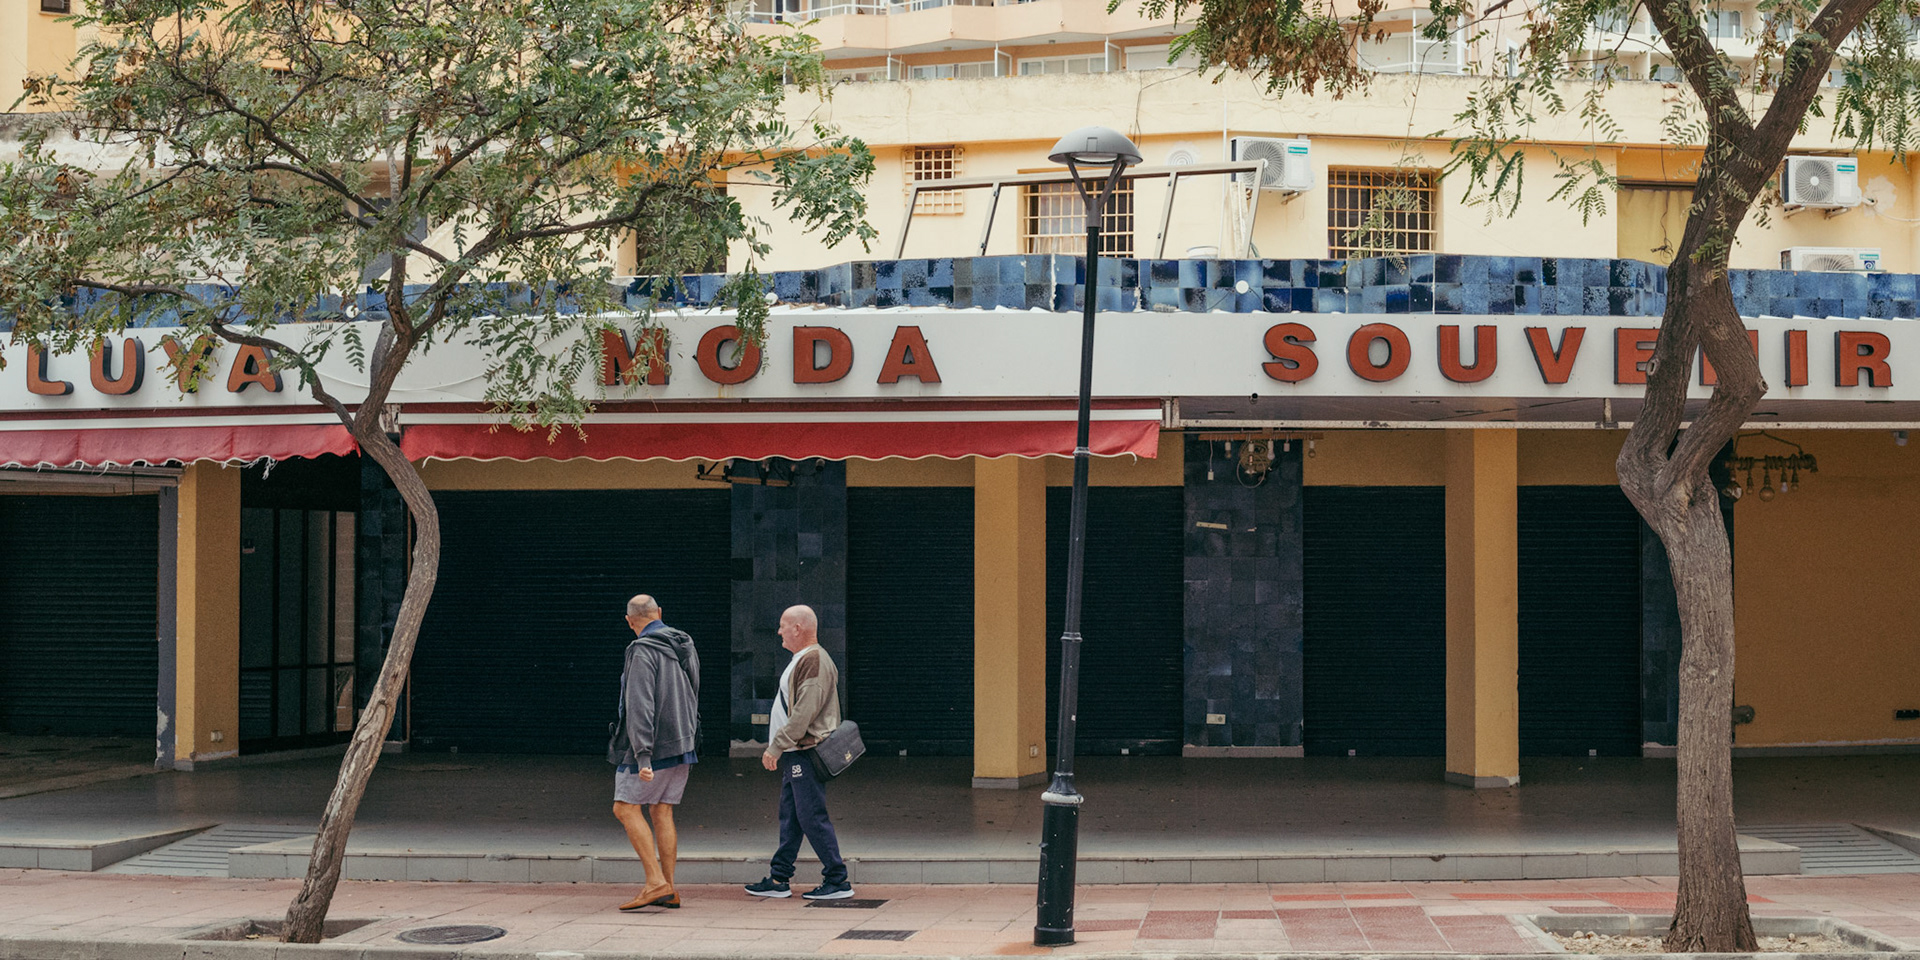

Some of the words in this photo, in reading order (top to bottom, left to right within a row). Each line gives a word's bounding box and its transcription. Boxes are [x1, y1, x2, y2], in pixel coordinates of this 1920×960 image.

[27, 334, 283, 395] LUYA
[602, 325, 942, 386] MODA
[1262, 322, 1893, 388] SOUVEIR
